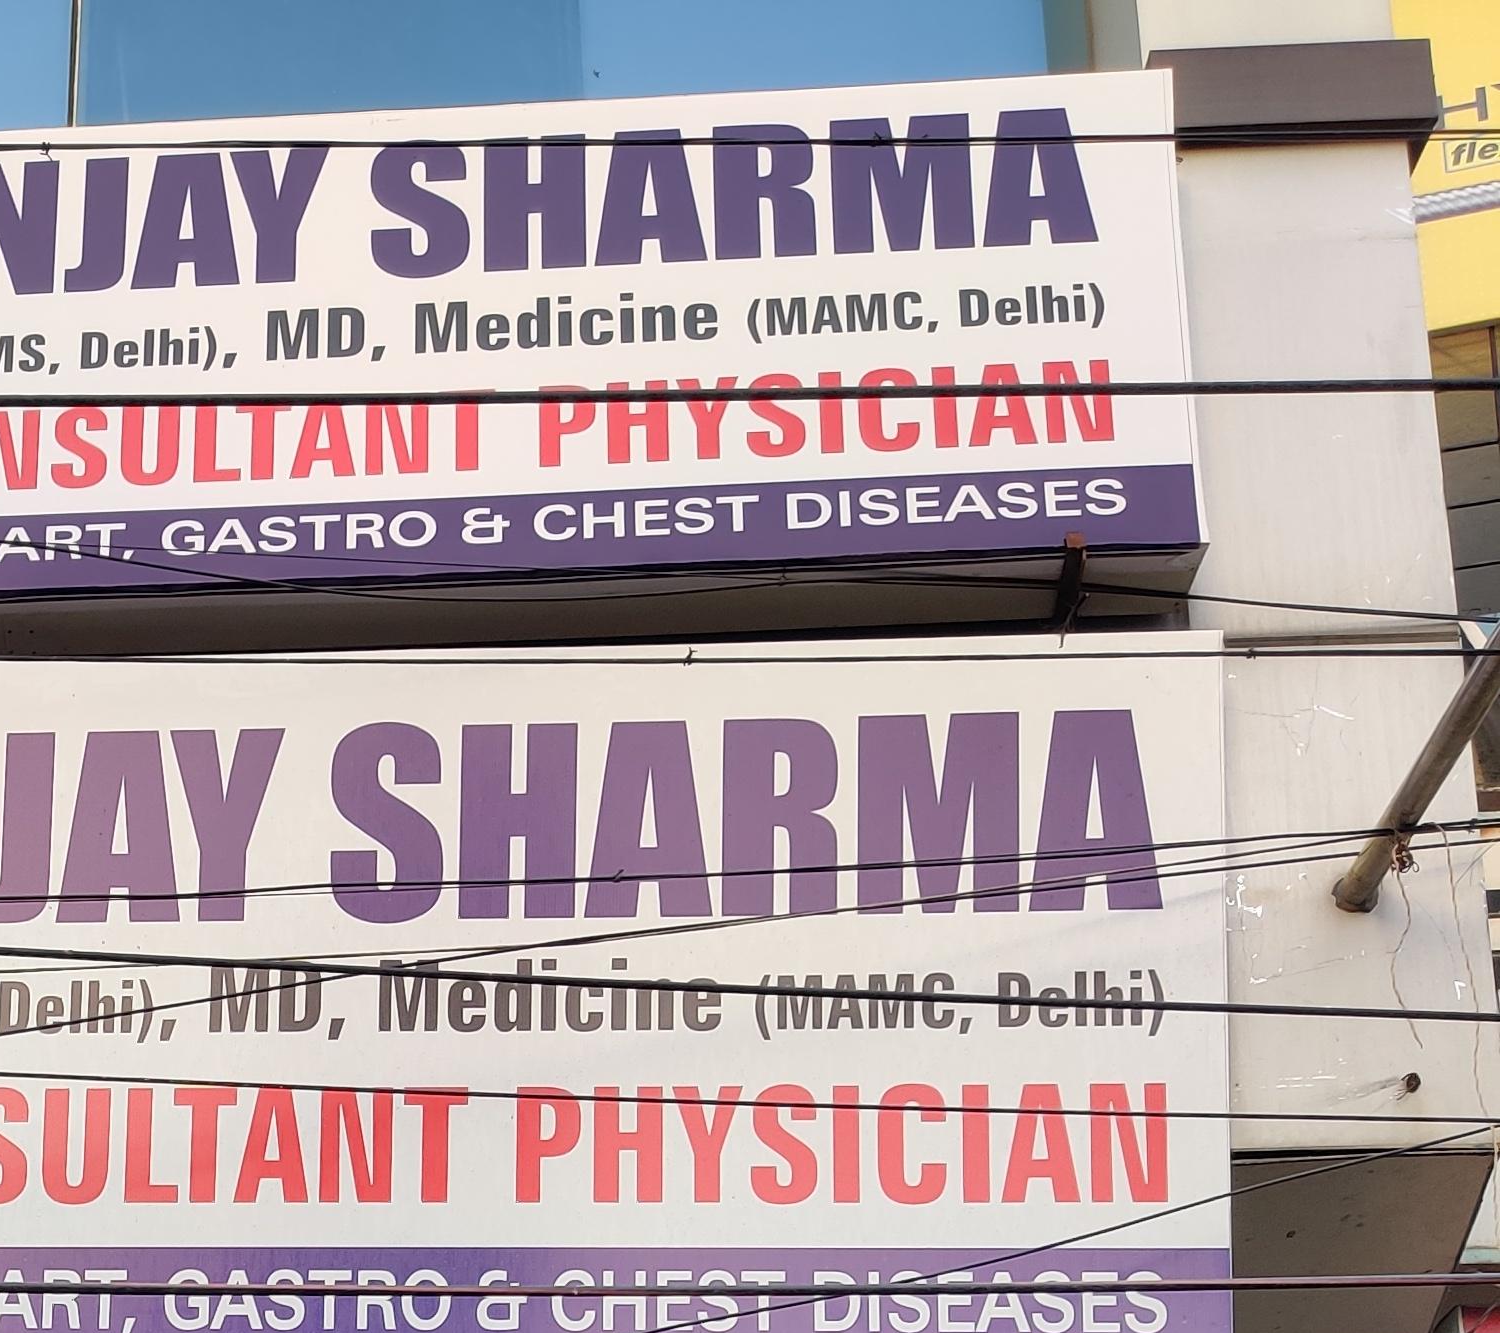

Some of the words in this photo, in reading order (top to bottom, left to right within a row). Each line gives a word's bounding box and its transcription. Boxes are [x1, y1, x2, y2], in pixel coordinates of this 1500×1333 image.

[370, 108, 1099, 279] SHARMA
[80, 325, 238, 371] Delhi),
[266, 306, 385, 363] MD,
[413, 293, 720, 355] Medicine
[747, 290, 940, 344] (MAMC,
[960, 282, 1106, 330] Delhi)
[538, 359, 1115, 468] PHYSICIAN
[160, 509, 437, 556] GASTRO
[461, 508, 511, 544] &
[532, 494, 760, 543] CHEST
[784, 477, 1129, 529] DISEASES
[329, 711, 1164, 924] SHARMA
[0, 978, 179, 1043] Delhi),
[208, 964, 344, 1042] MD,
[377, 958, 723, 1033] Medicine
[754, 973, 973, 1040] (MAMC,
[999, 970, 1166, 1036] Delhi)
[515, 1083, 1169, 1205] PHYSICIAN
